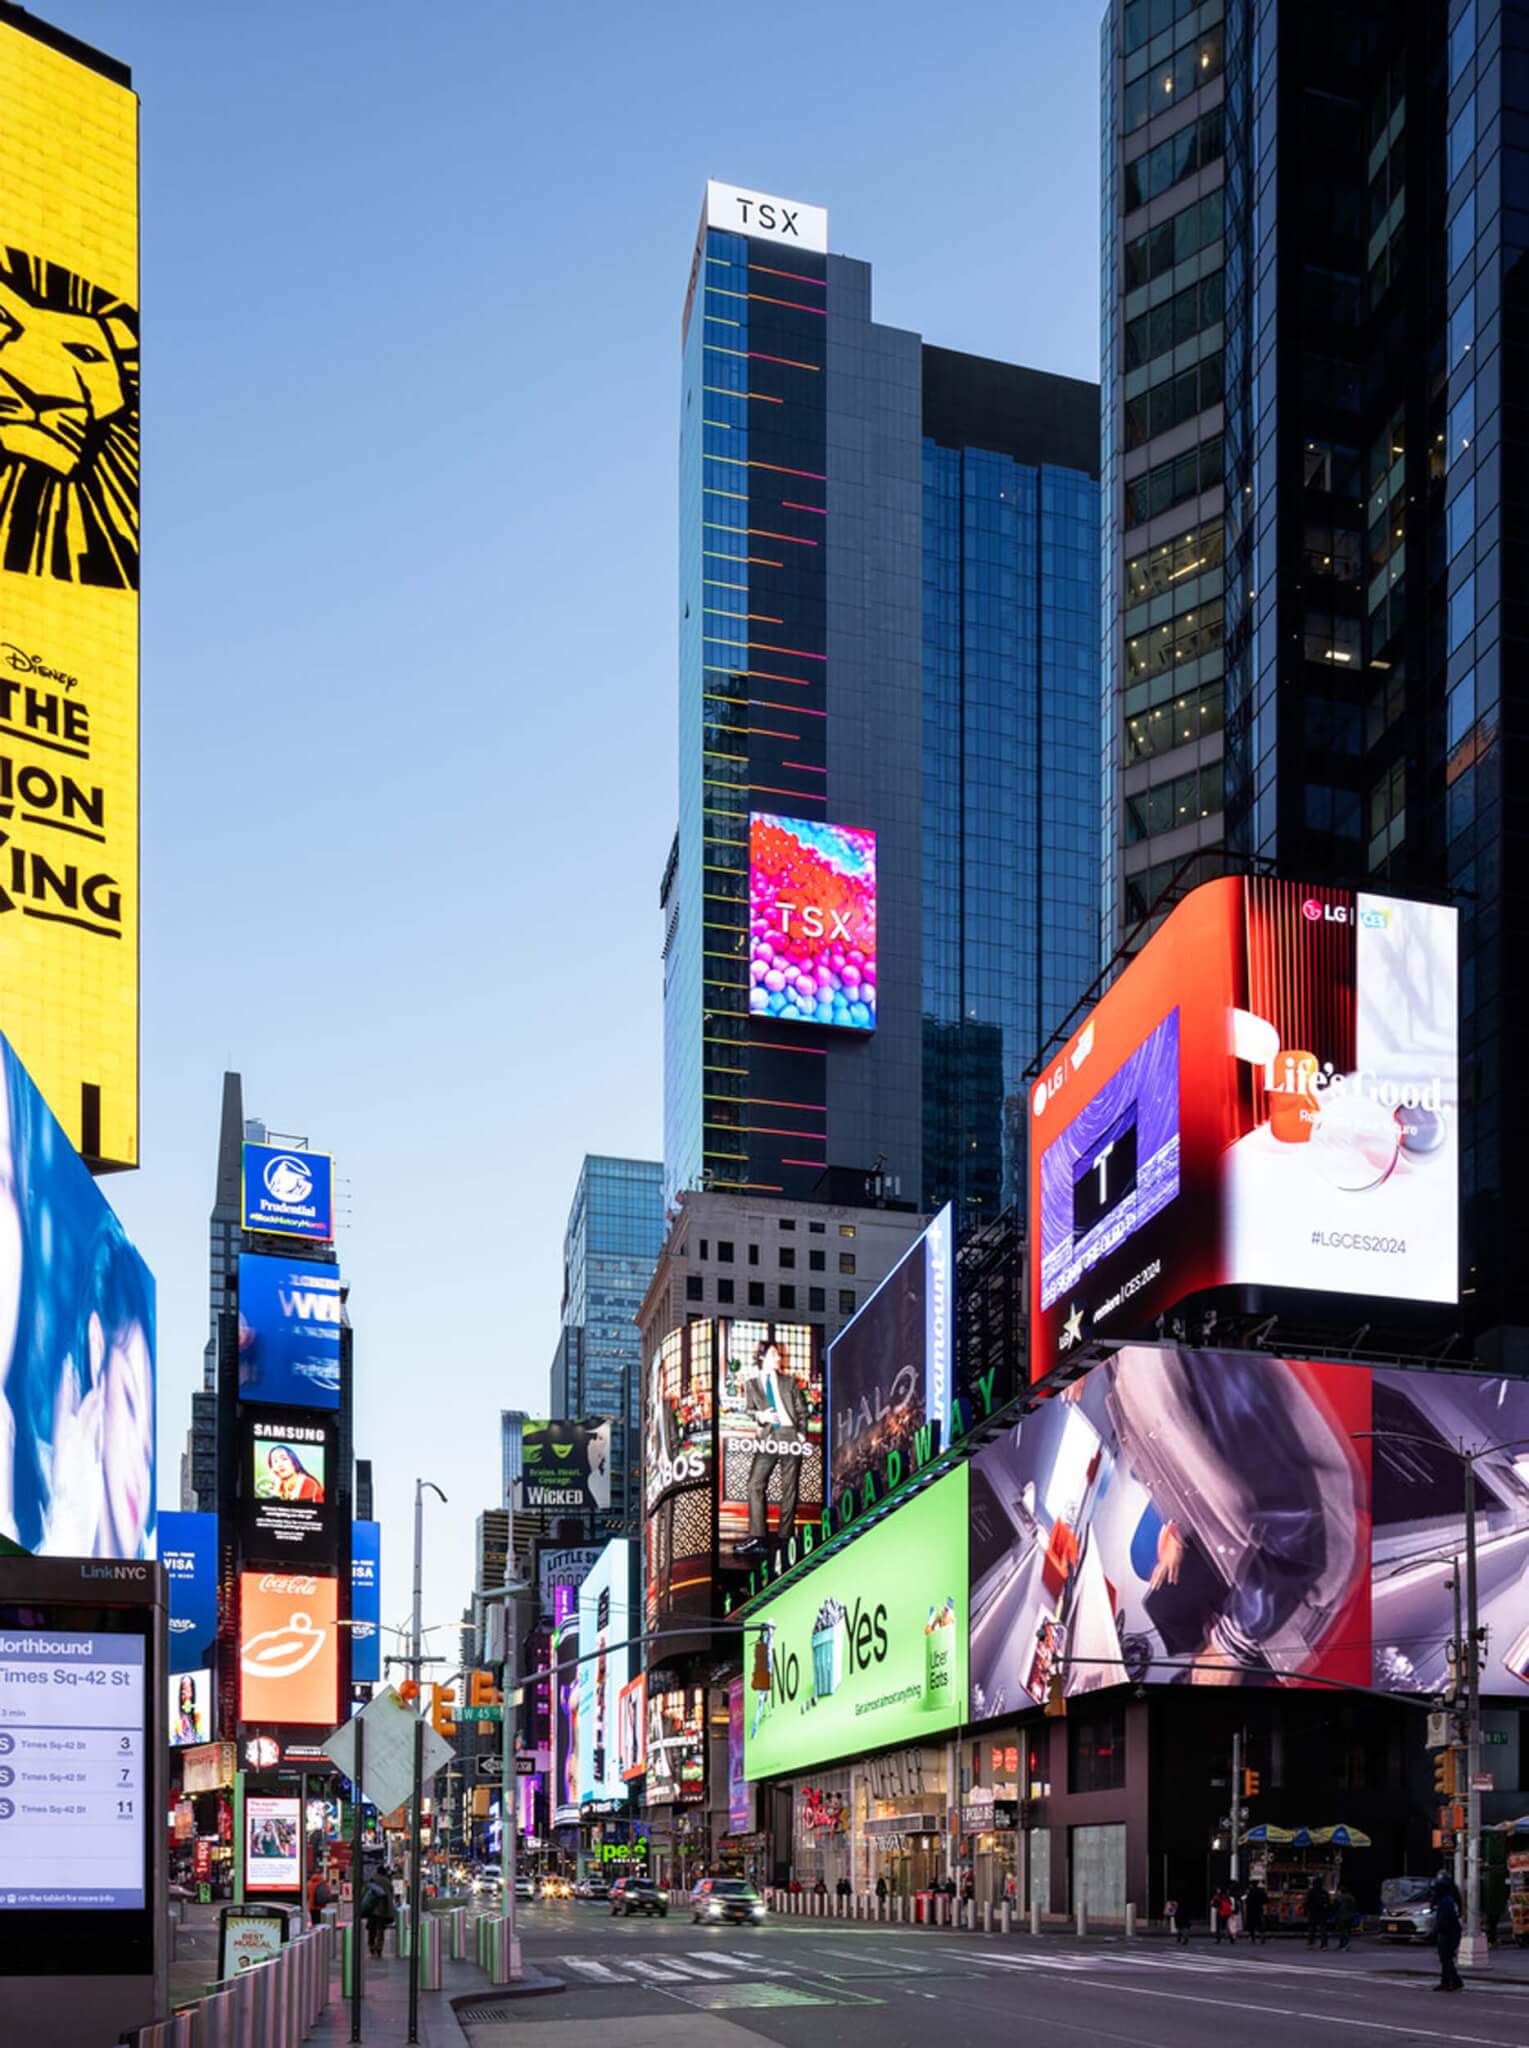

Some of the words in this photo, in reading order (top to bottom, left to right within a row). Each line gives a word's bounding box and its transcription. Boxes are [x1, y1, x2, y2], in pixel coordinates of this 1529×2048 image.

[736, 197, 799, 236] TSX
[1, 642, 78, 692] Disney
[0, 677, 89, 745] THE
[0, 755, 104, 828] ION
[774, 902, 852, 942] TSX
[1325, 903, 1347, 924] LG
[1047, 1065, 1064, 1100] LG
[1264, 1056, 1347, 1098] Life's
[260, 1199, 317, 1217] Prudential
[1311, 1230, 1406, 1254] #LGCES2024
[254, 1423, 325, 1442] SAMSUNG
[727, 1438, 815, 1457] BONOBOS
[803, 1366, 997, 1553] BROADWAY
[163, 1558, 195, 1571] VISA
[547, 1550, 580, 1572] LITTLE
[81, 1564, 147, 1581] LinkNYC
[352, 1567, 374, 1578] ISA
[259, 1574, 317, 1595] Coca-Cola
[770, 1641, 799, 1709] No
[843, 1597, 888, 1675] Yes
[53, 1669, 107, 1687] Sq-42
[111, 1670, 130, 1686] St
[463, 1708, 473, 1720] W
[478, 1708, 490, 1719] 45
[21, 1740, 47, 1748] Times
[120, 1736, 130, 1749] 3
[21, 1772, 47, 1781] Times
[120, 1768, 130, 1781] 7
[21, 1804, 47, 1813] Times
[117, 1801, 133, 1813] 11
